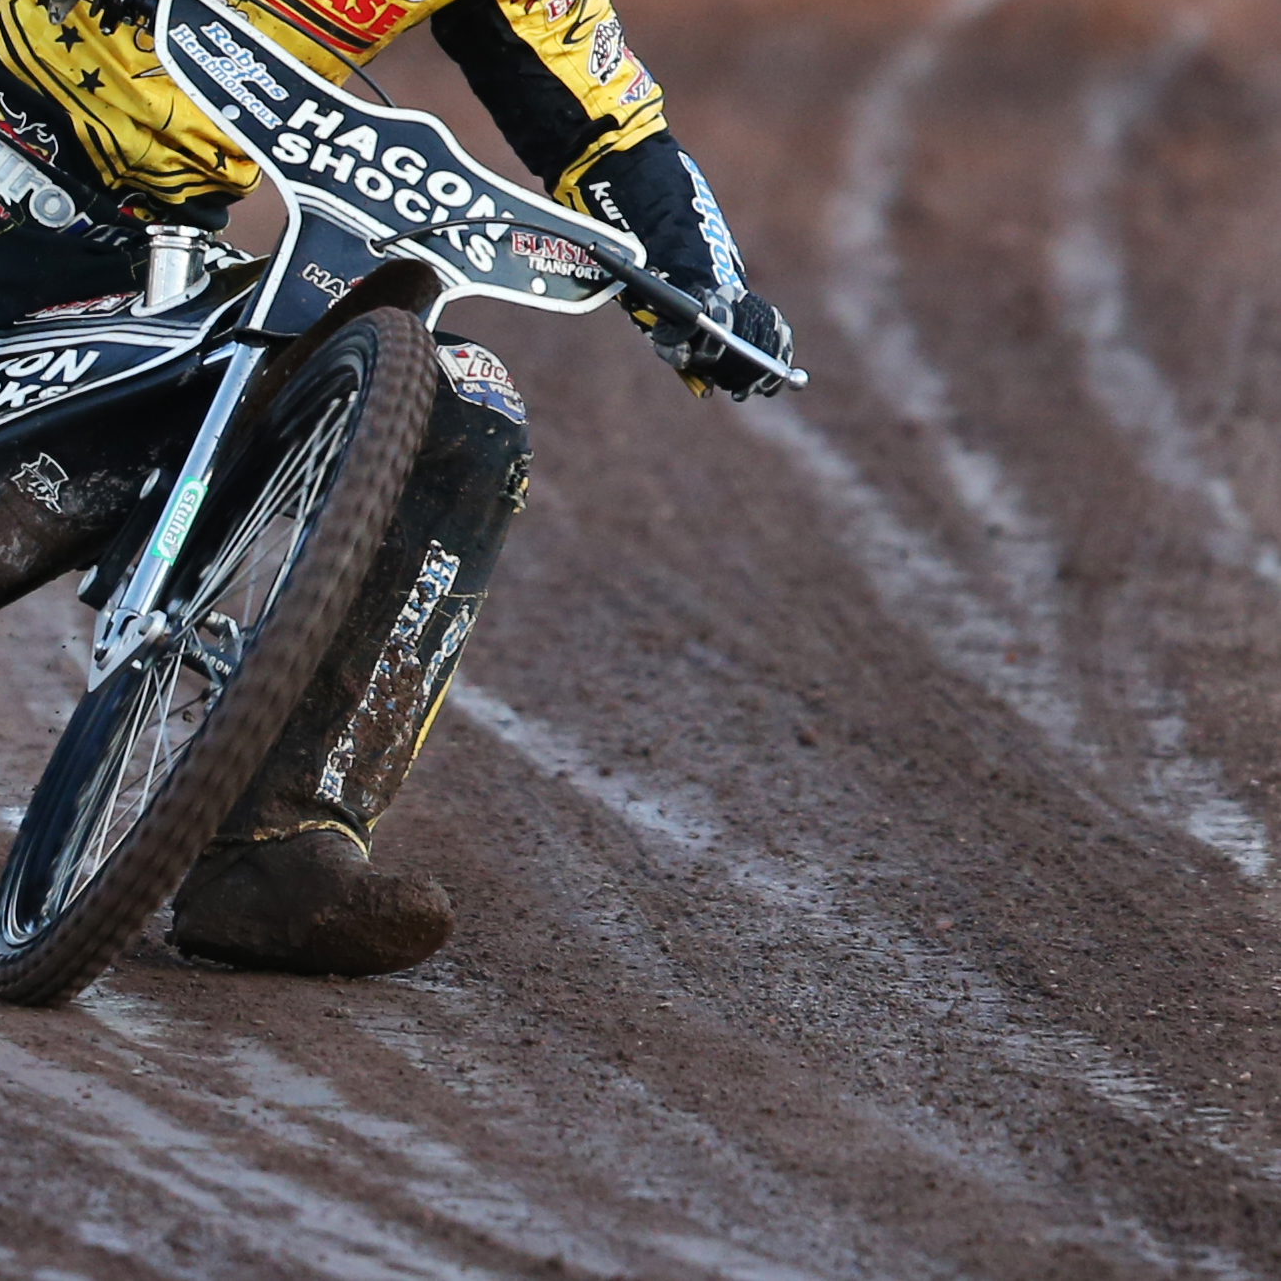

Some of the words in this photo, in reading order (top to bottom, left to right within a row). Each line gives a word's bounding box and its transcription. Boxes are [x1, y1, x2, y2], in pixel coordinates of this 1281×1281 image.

[170, 24, 282, 129] Herstmonceux
[201, 21, 289, 101] Robins
[271, 132, 495, 273] SHOCKS
[287, 99, 516, 243] HAGON
[527, 255, 603, 282] TRANSPORT
